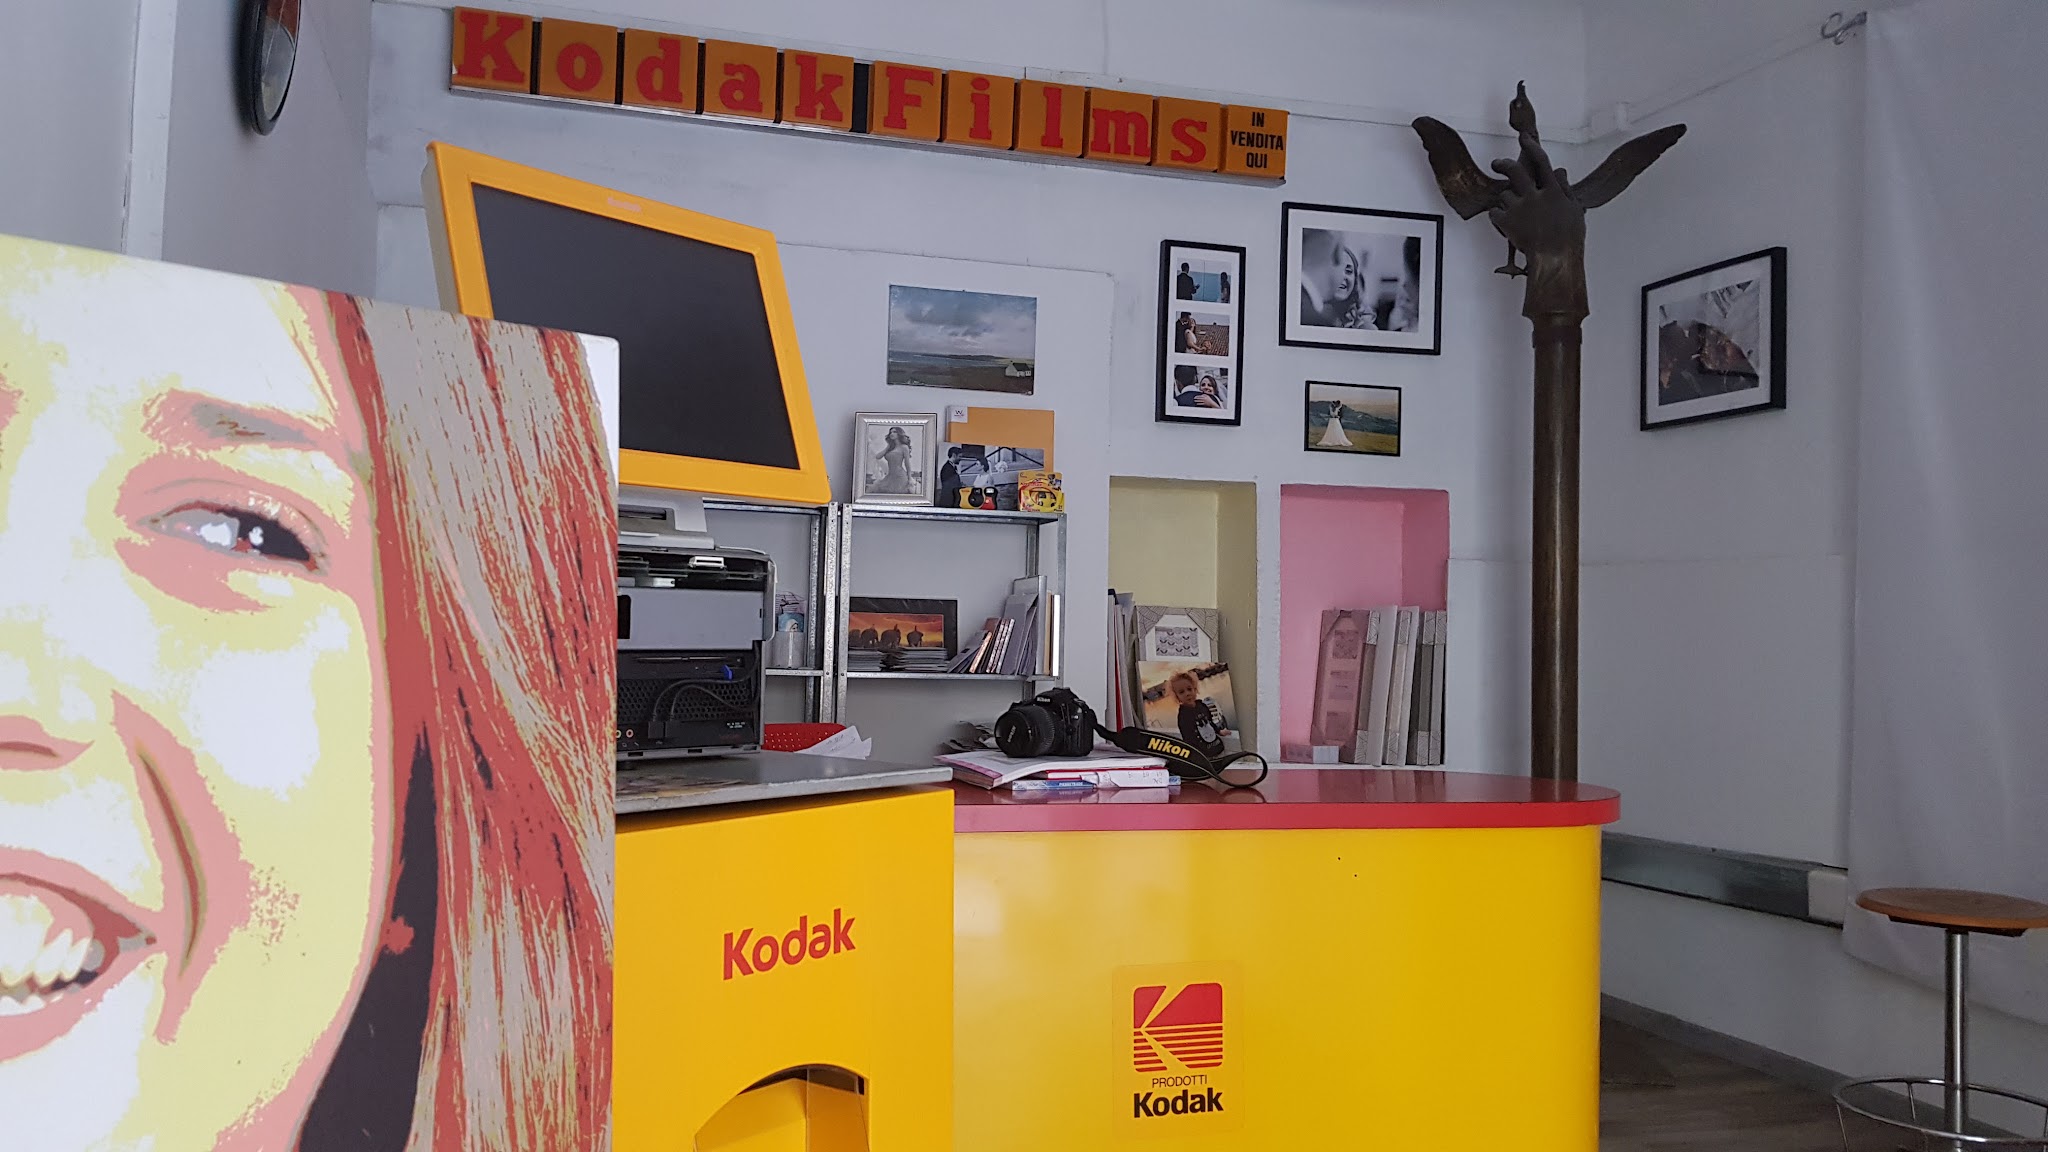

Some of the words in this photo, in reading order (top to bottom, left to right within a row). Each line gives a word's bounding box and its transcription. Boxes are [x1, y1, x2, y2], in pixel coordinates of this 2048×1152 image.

[456, 11, 843, 122] Kodak
[883, 66, 1207, 163] Films
[1252, 111, 1265, 127] IN
[1231, 130, 1284, 150] VENDITA
[1246, 152, 1267, 168] QUI
[1147, 737, 1191, 758] Nikon
[723, 908, 856, 980] Kodak
[1152, 1074, 1208, 1088] PRODOTTI
[1134, 1087, 1224, 1118] Kodak
